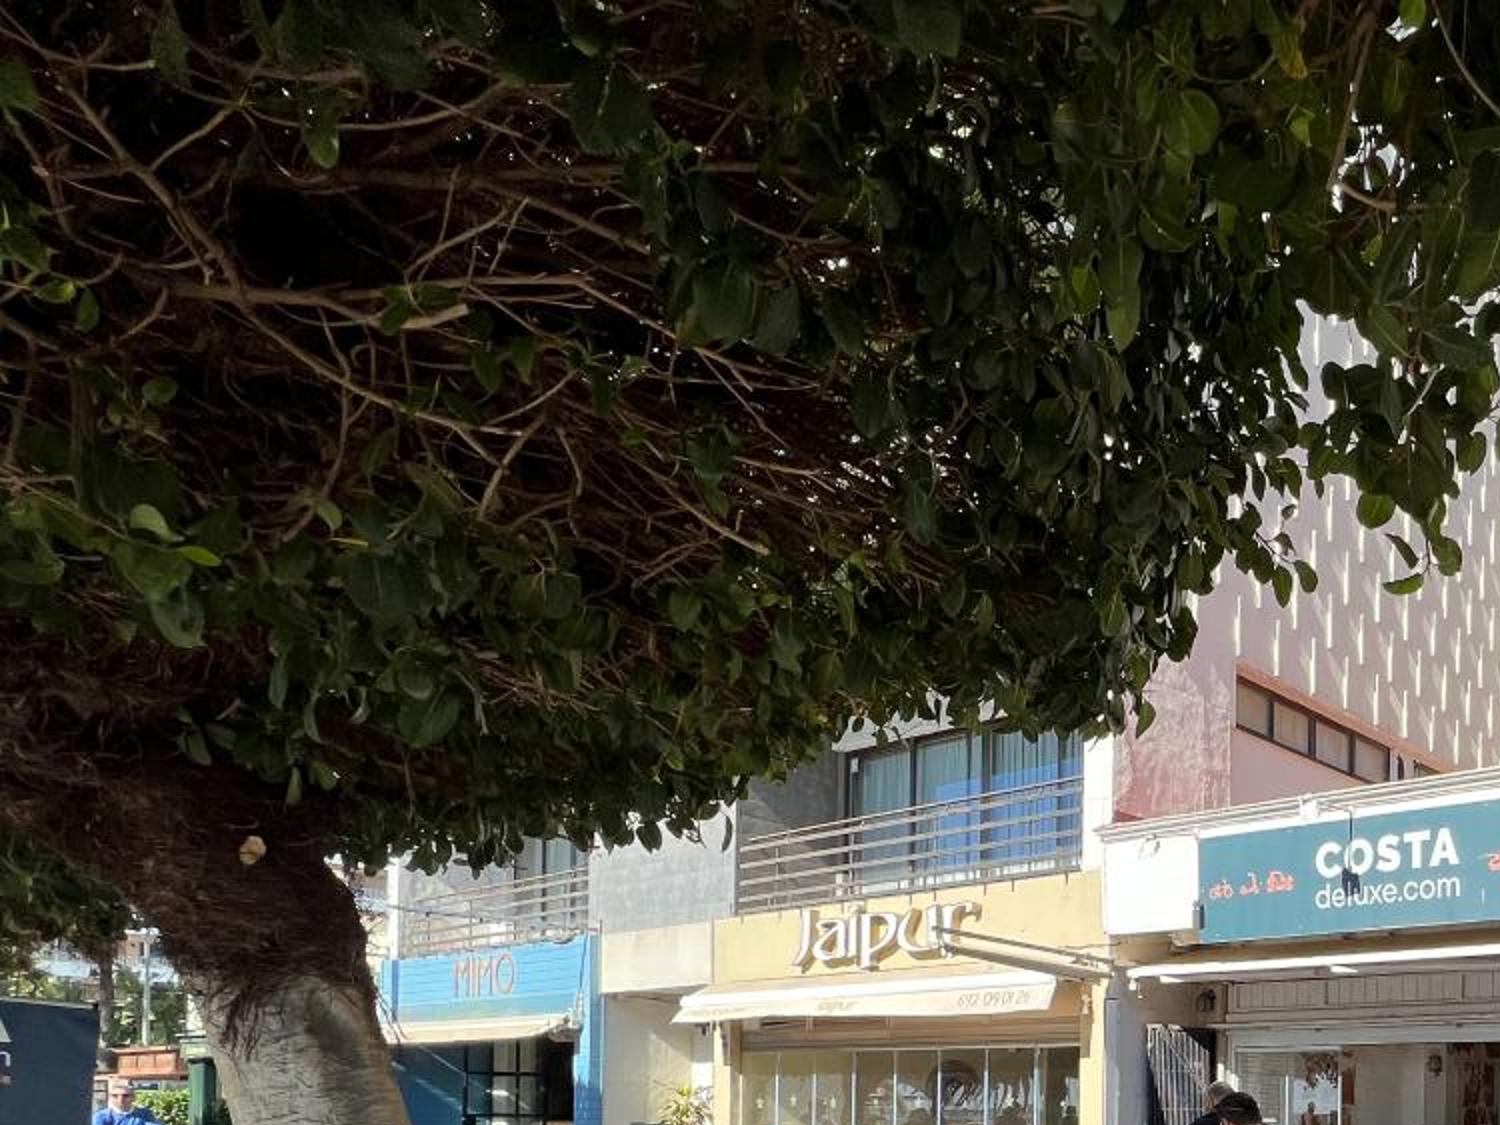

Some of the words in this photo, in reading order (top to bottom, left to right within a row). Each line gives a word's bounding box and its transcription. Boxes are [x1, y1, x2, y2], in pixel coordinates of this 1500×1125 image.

[1315, 827, 1460, 879] COSTA
[1314, 875, 1461, 909] deluxe.com
[792, 901, 981, 973] Jaipur
[452, 953, 515, 997] MIMO
